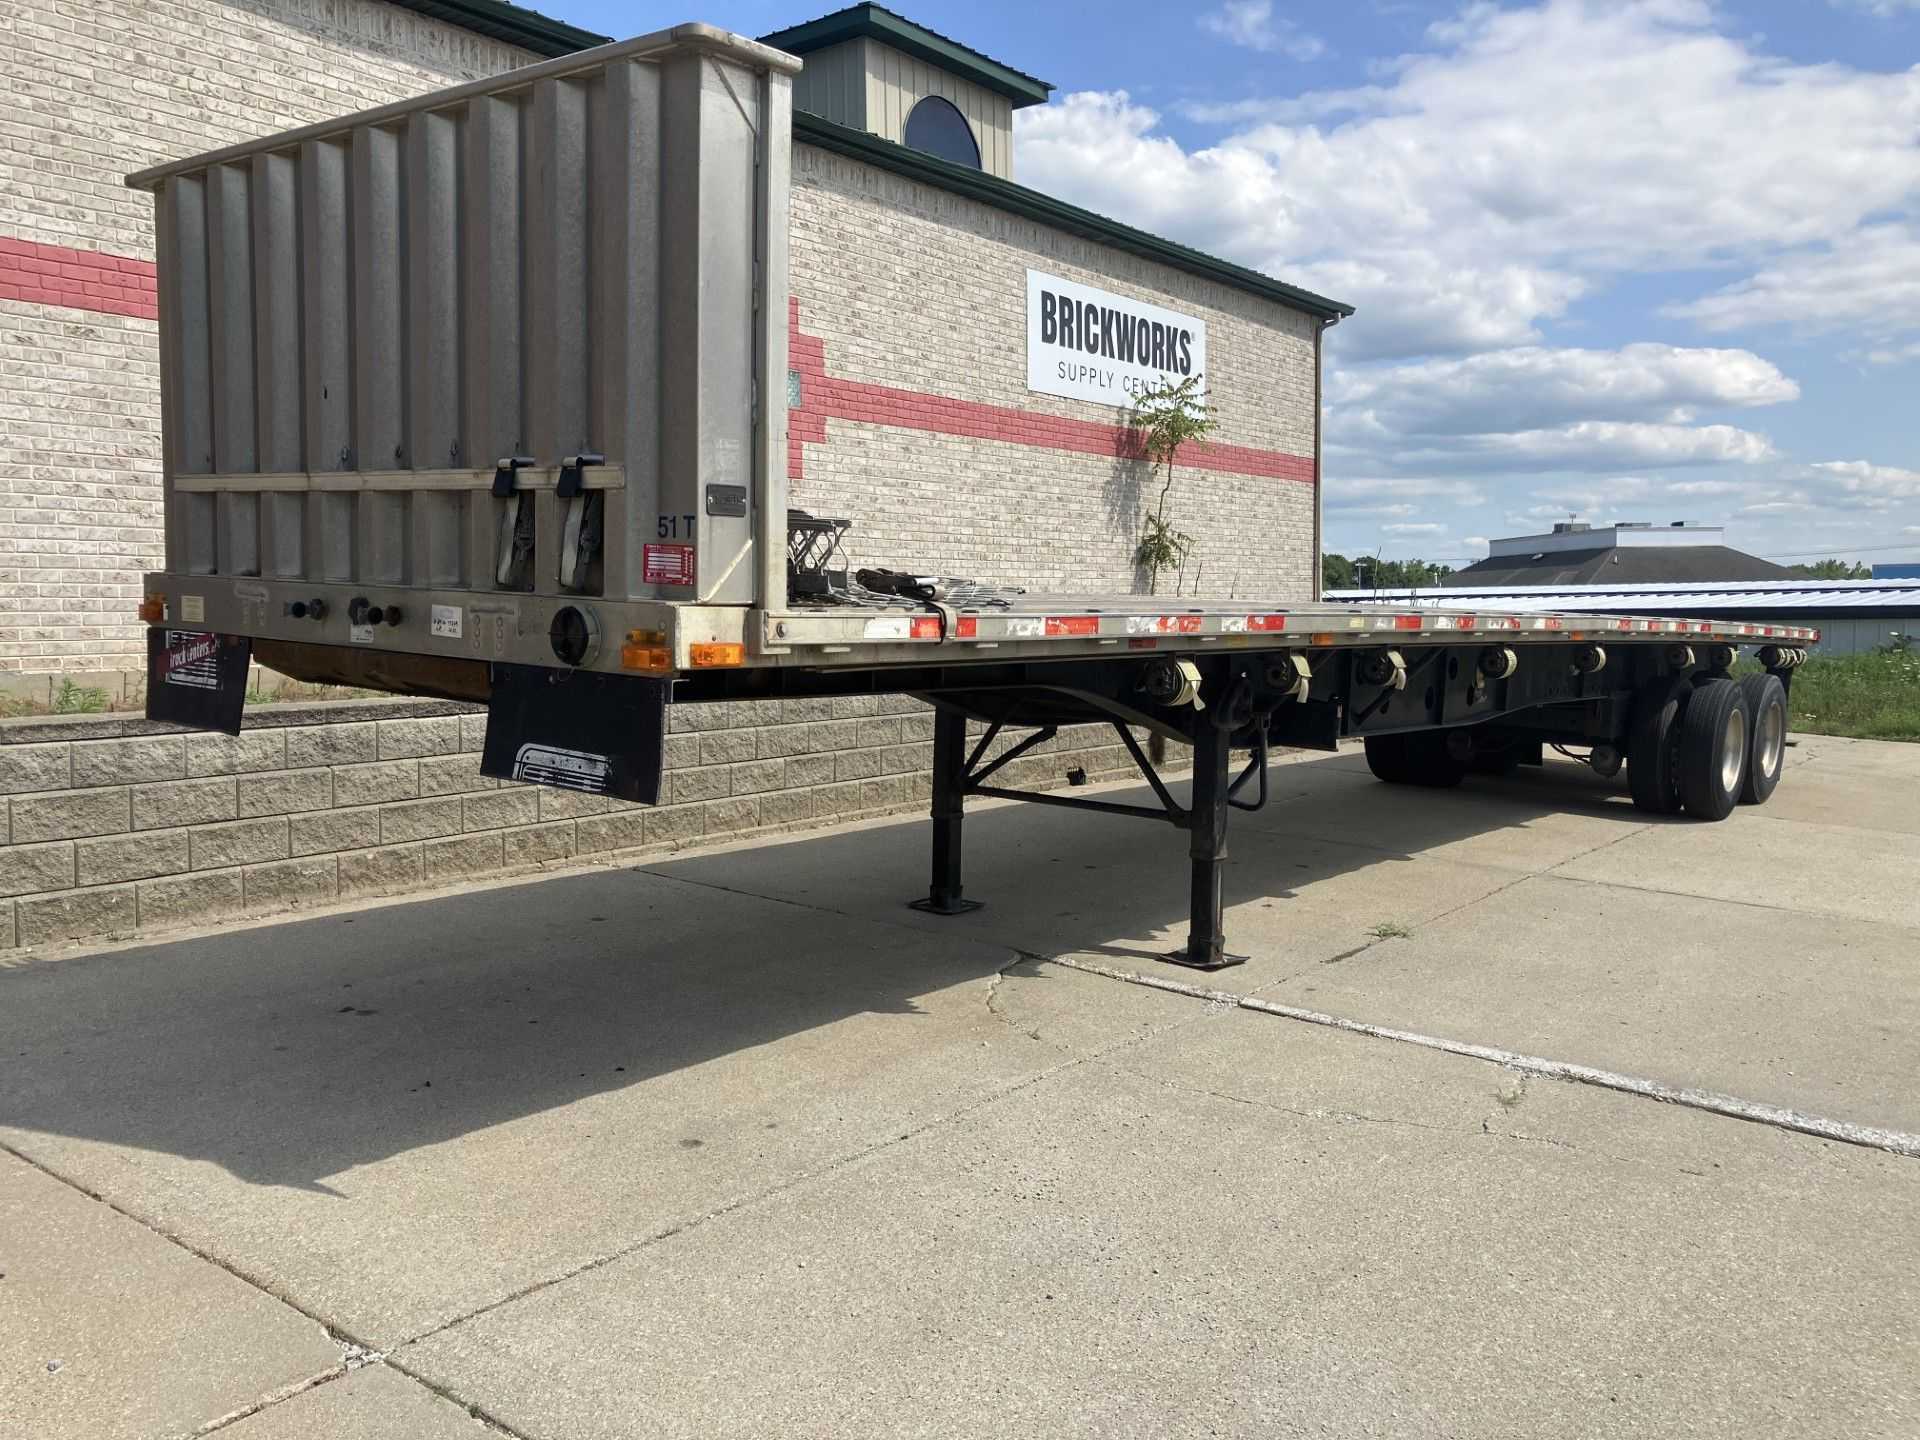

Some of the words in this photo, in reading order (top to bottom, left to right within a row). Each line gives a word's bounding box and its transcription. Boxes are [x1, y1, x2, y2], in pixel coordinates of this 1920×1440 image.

[1041, 290, 1192, 377] BRICKWORKS
[1058, 361, 1114, 389] SUPPLY
[1123, 375, 1177, 400] CENTE
[658, 515, 677, 538] 51
[683, 515, 695, 538] T
